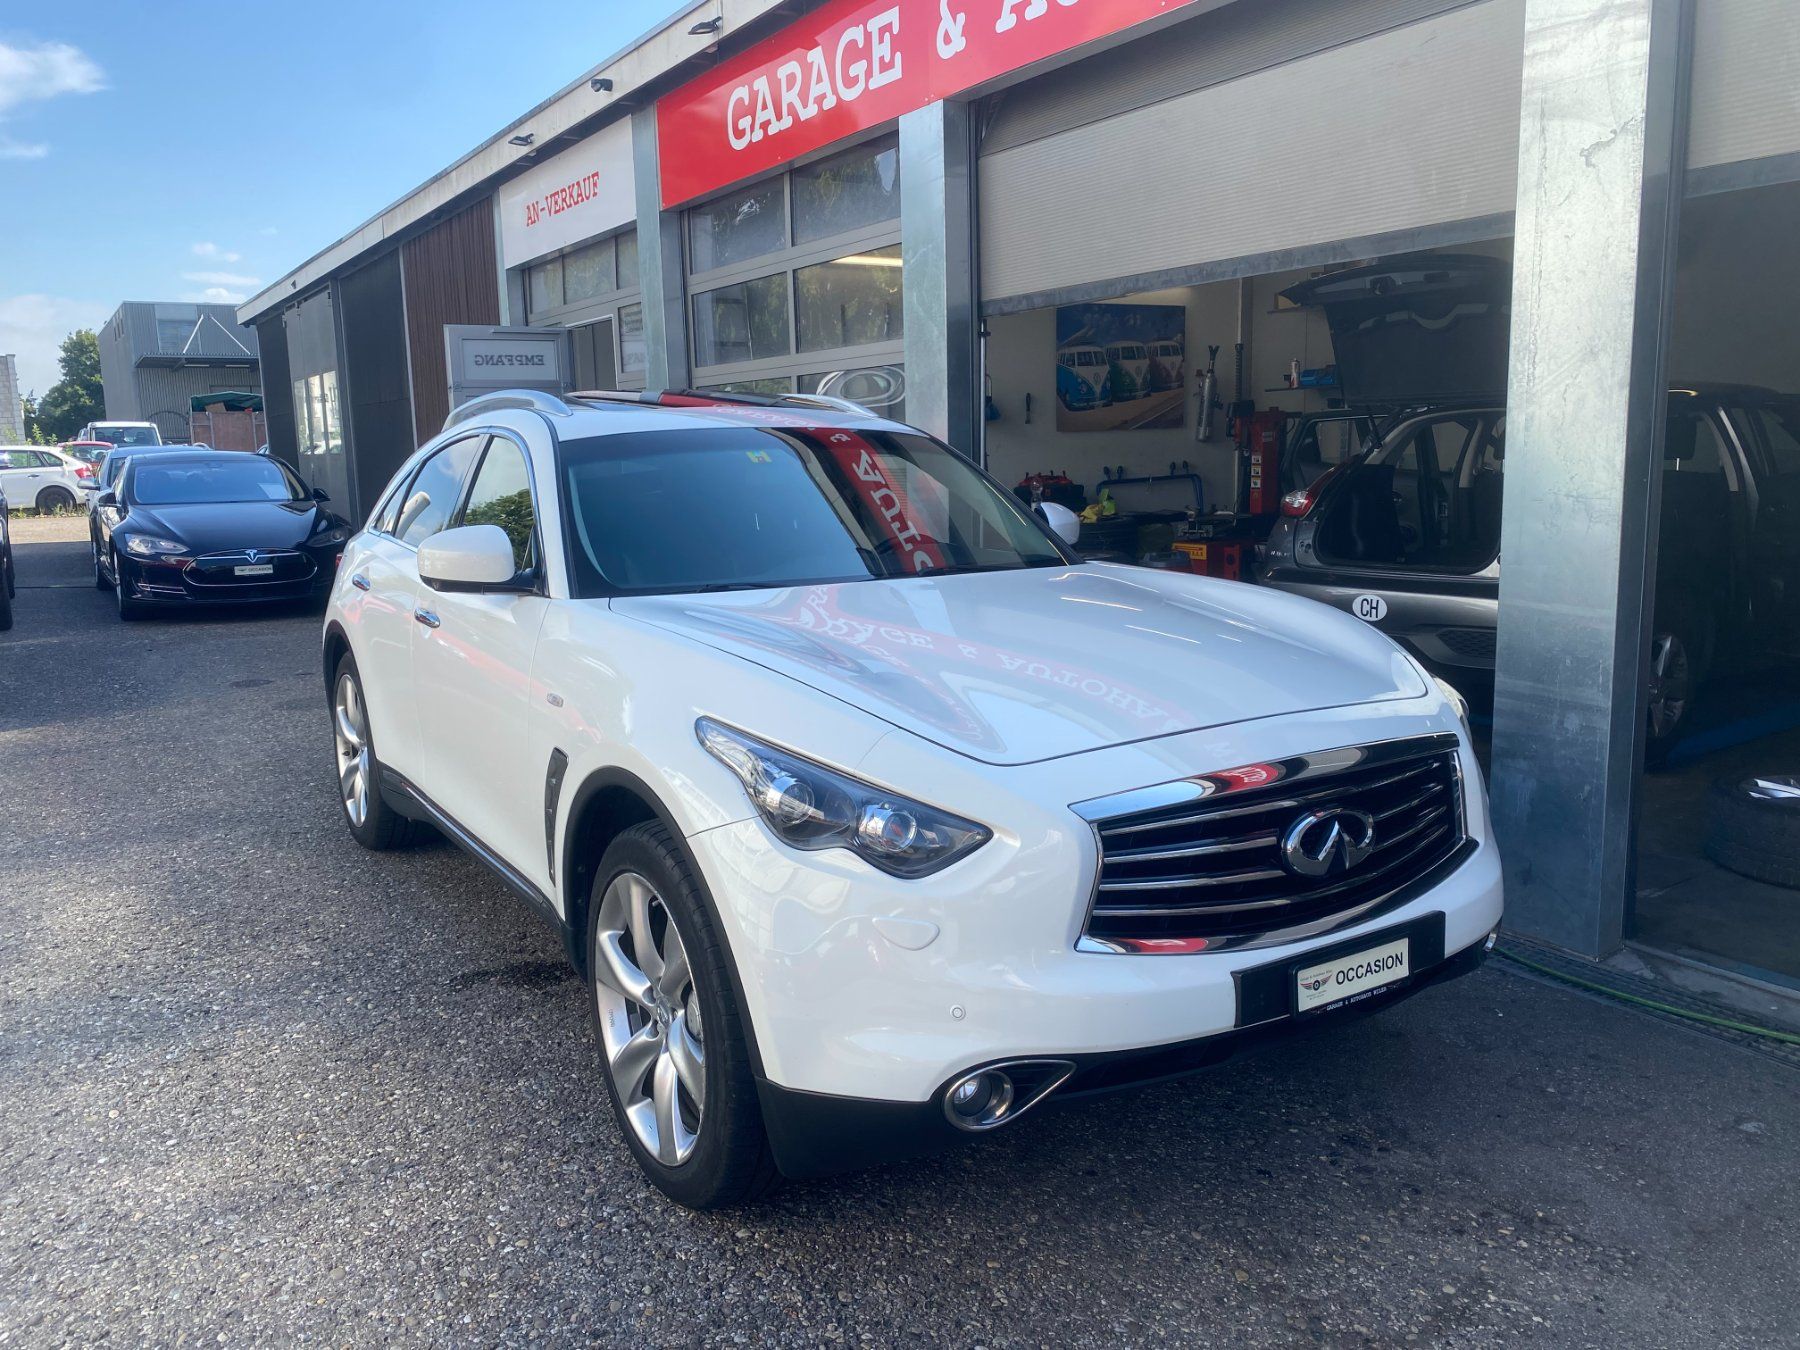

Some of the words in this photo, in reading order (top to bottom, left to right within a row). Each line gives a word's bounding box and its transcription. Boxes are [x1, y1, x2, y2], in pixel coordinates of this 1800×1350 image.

[727, 6, 902, 151] GARAGE
[526, 171, 600, 228] AN-VERKAUF
[1360, 598, 1379, 618] CH
[1335, 952, 1403, 985] OCCASION
